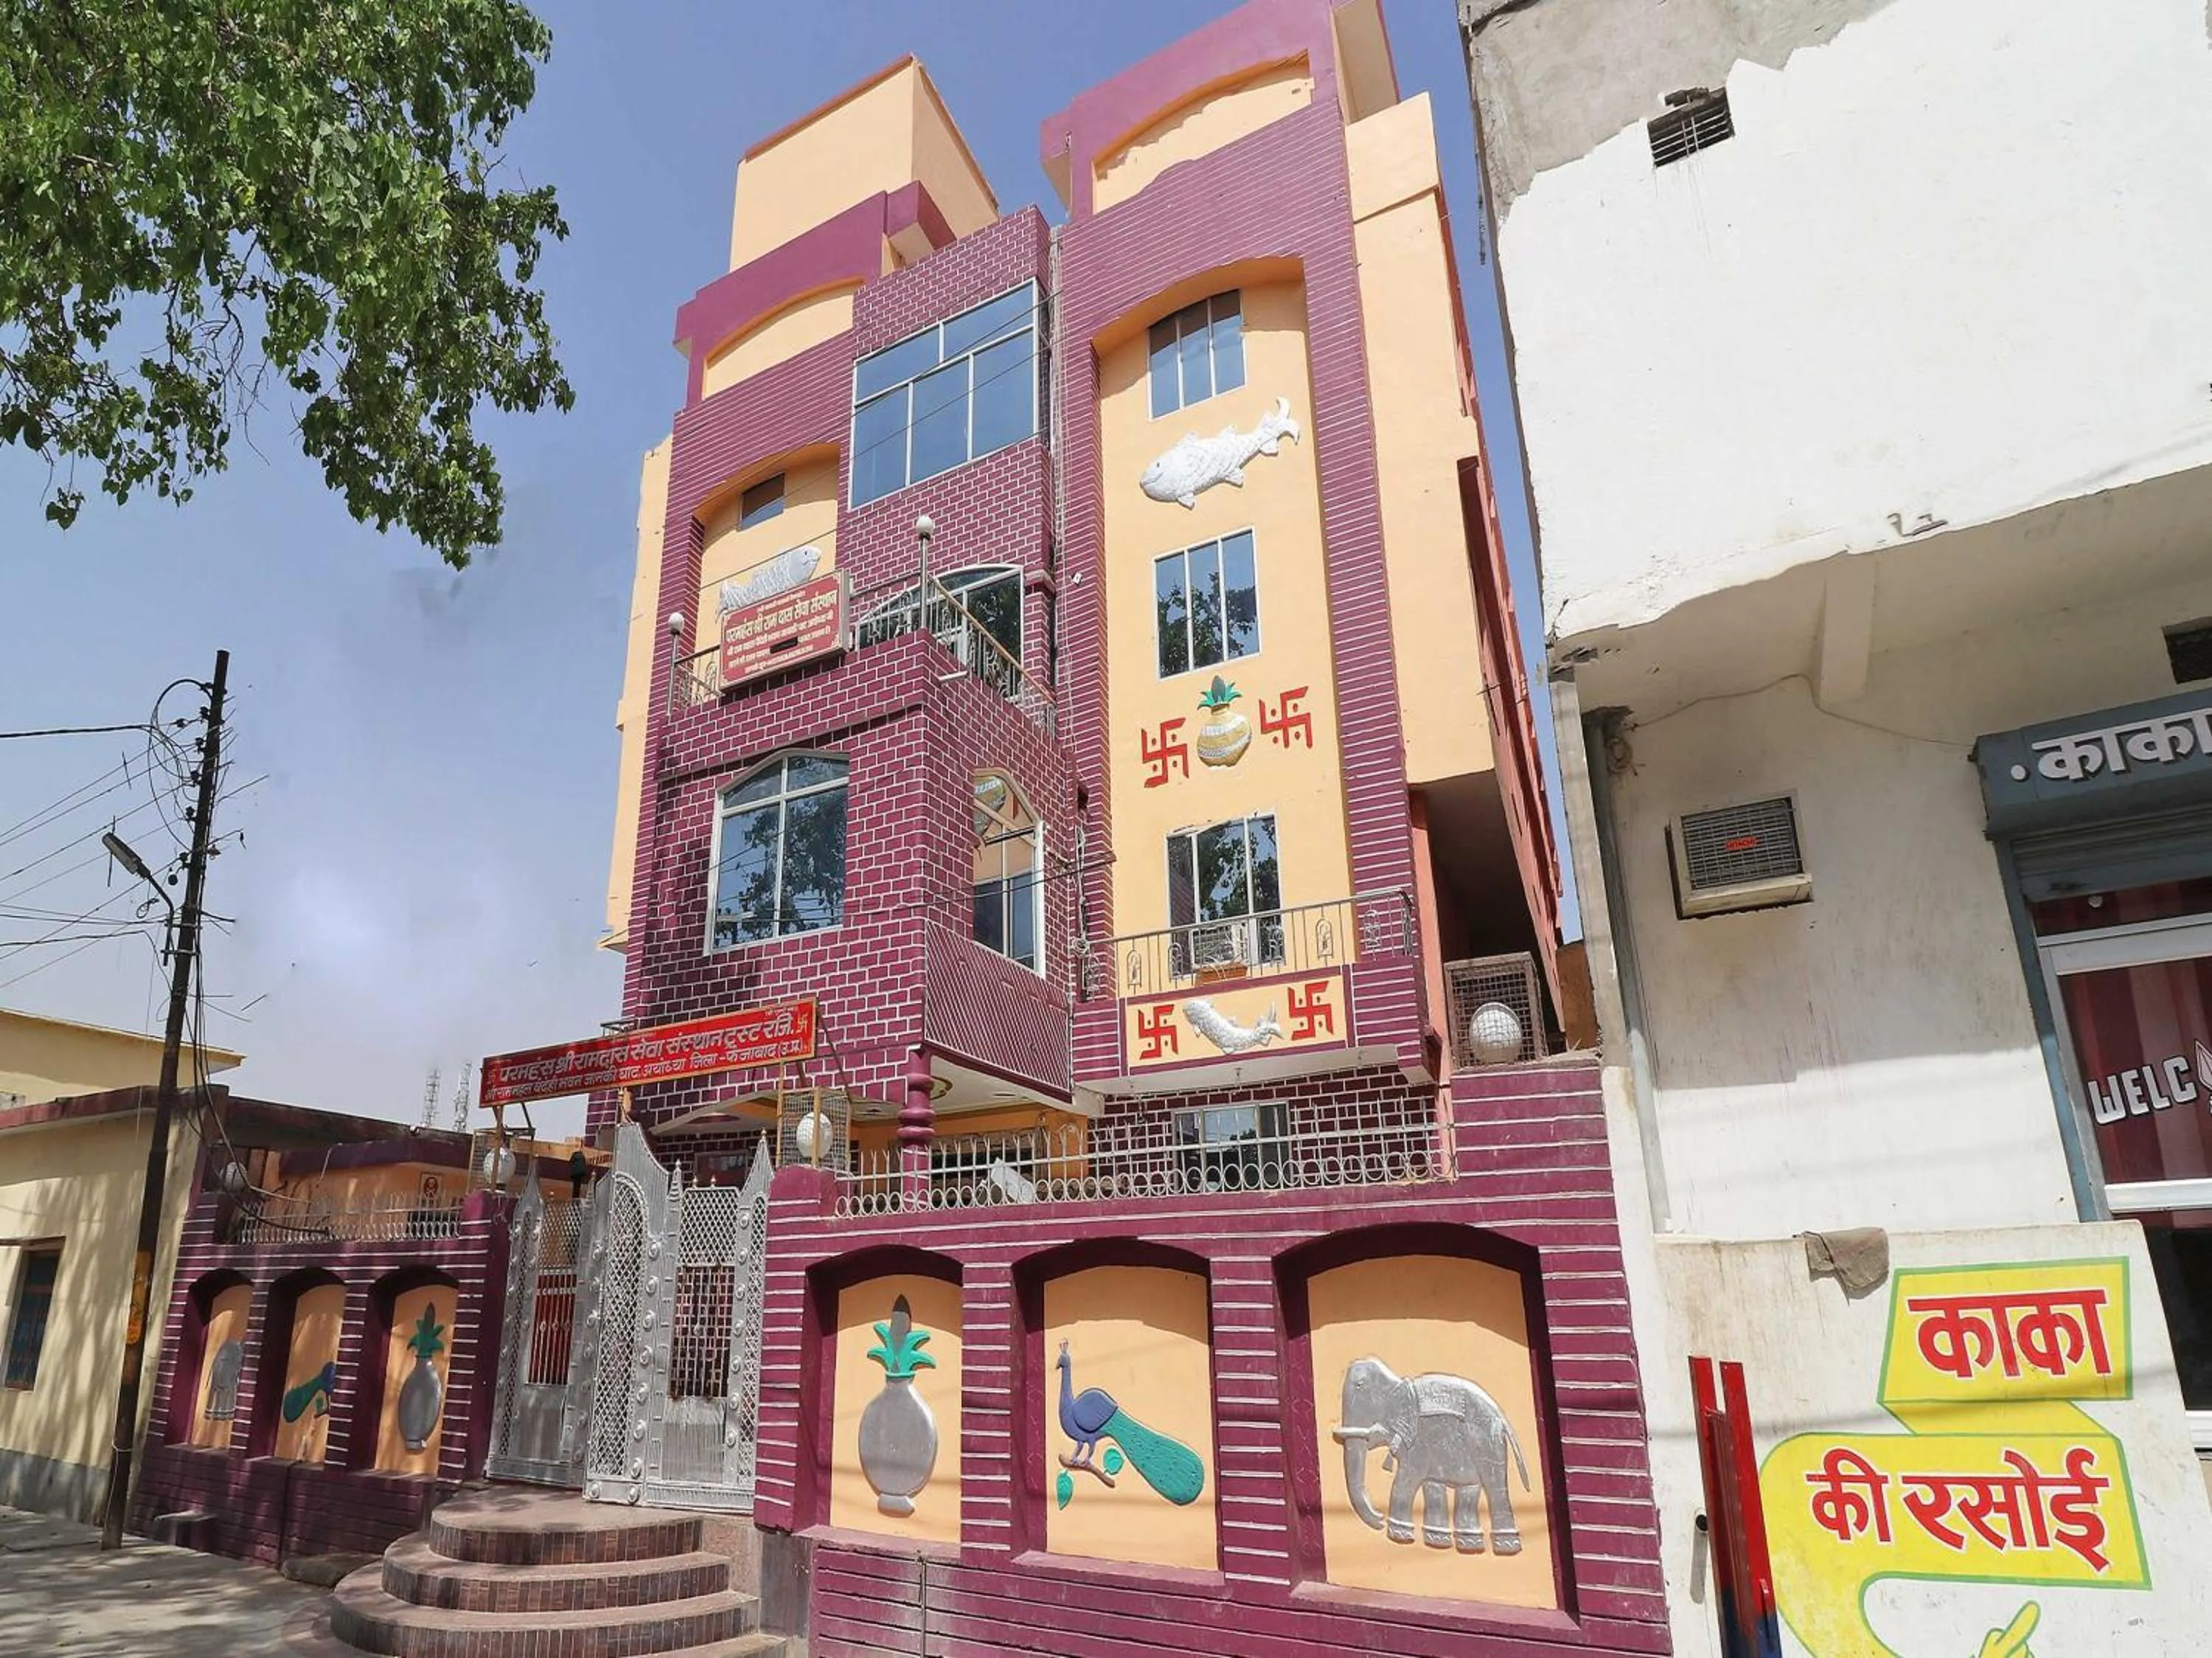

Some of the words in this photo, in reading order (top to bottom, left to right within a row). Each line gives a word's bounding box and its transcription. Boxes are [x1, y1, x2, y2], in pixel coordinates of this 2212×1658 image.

[630, 1037, 666, 1061] सेवा
[666, 1032, 724, 1052] संस्थान
[1907, 1288, 2112, 1379] काका
[1805, 1447, 1893, 1543] की
[1902, 1447, 2111, 1572] रसोई
